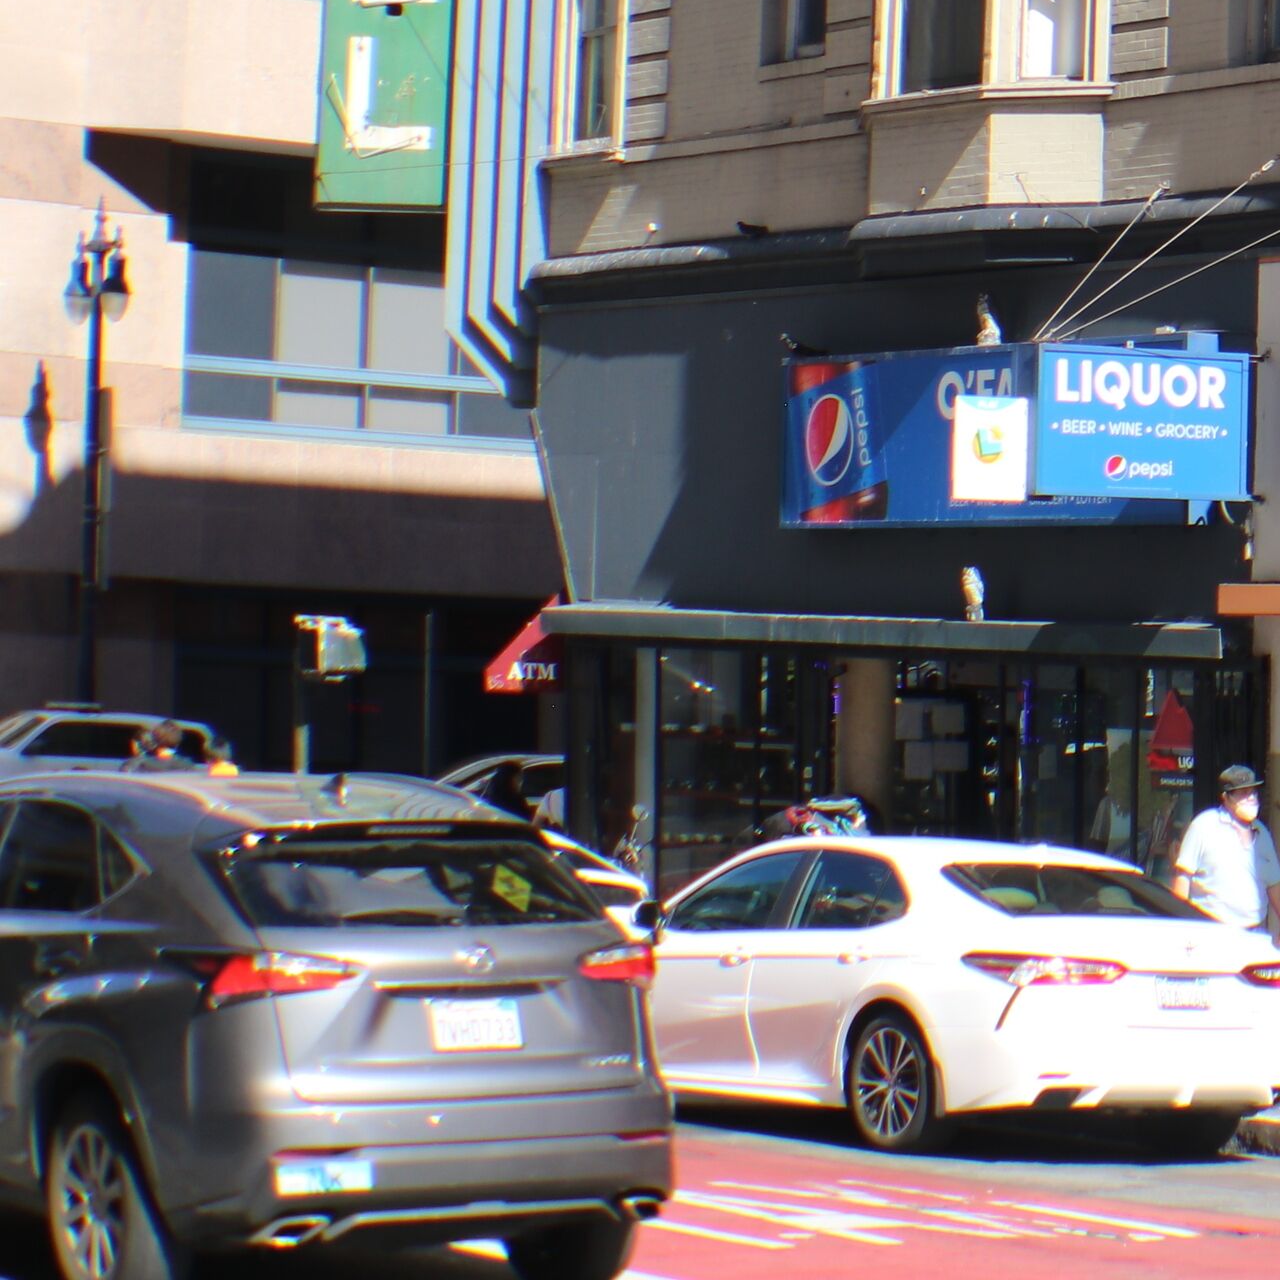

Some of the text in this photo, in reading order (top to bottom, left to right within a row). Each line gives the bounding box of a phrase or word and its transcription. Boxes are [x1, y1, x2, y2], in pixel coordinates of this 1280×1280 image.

[1055, 358, 1227, 411] LIQUOR
[850, 386, 872, 467] pepsi
[1062, 419, 1220, 439] BEER WINE GROCERY
[1128, 460, 1173, 480] pepsi
[507, 660, 557, 681] ATM
